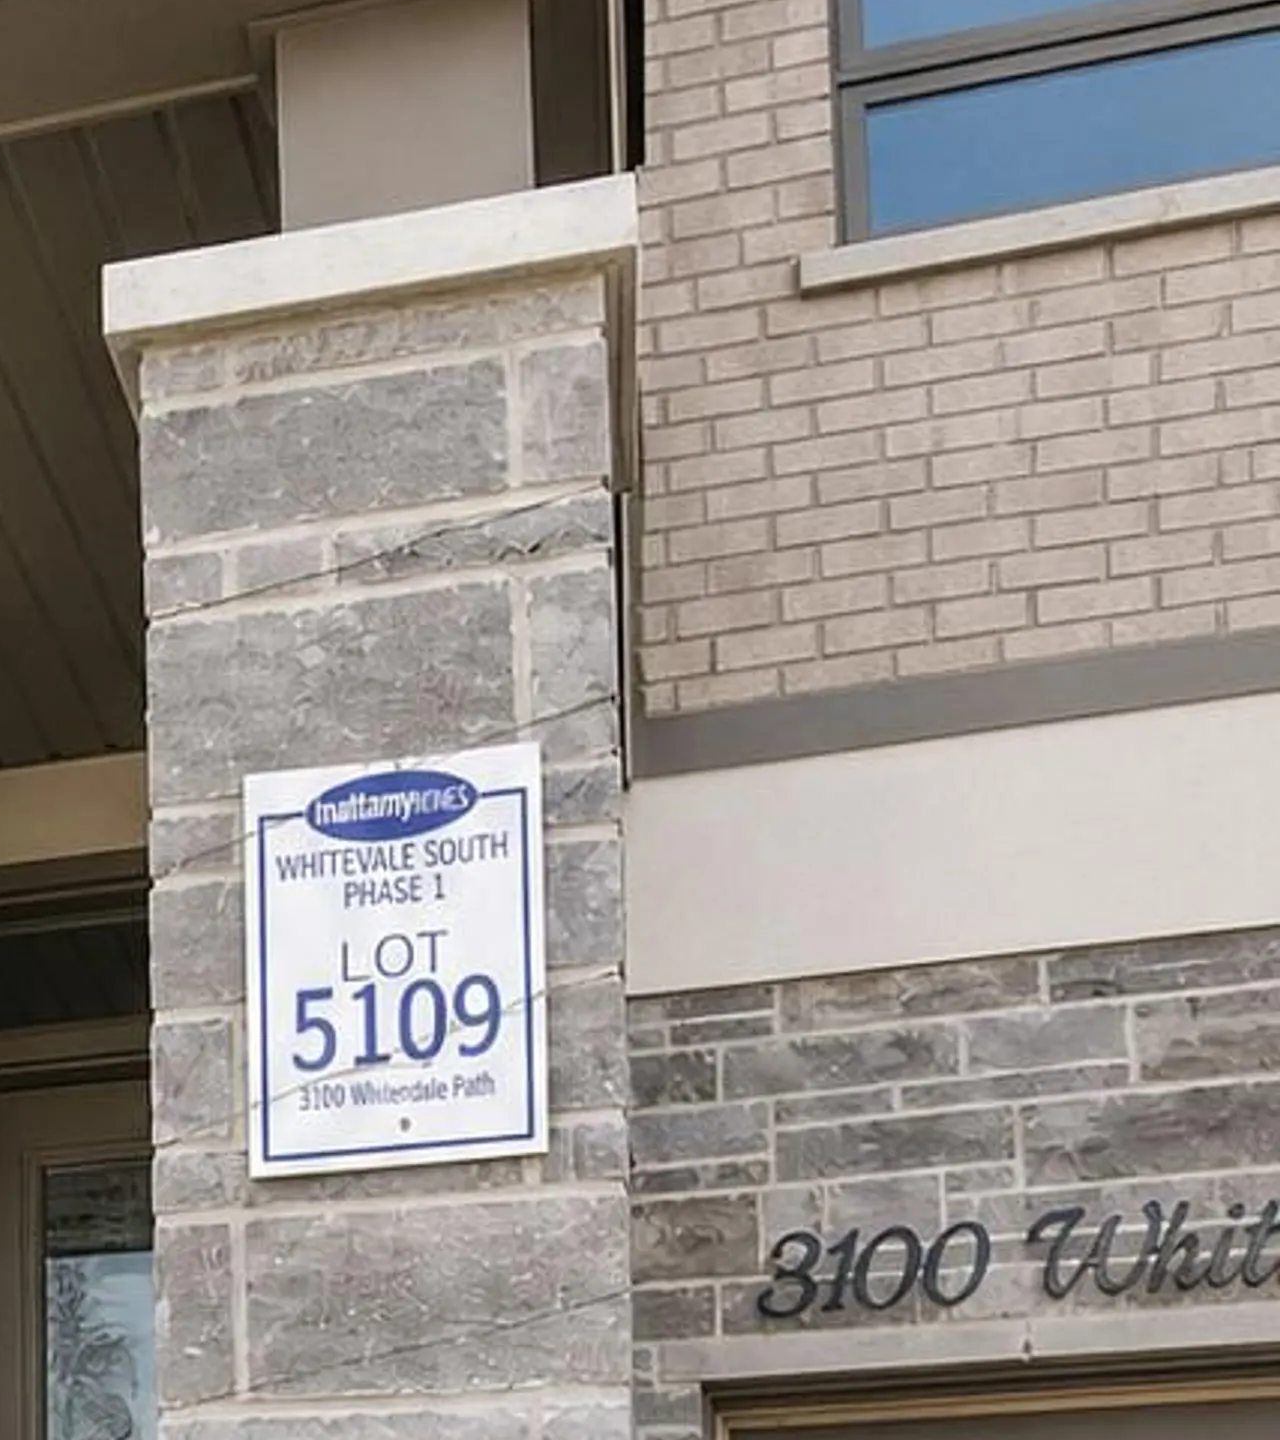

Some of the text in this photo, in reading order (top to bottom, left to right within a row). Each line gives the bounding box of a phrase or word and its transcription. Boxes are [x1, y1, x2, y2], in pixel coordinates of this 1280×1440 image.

[275, 831, 509, 882] WHITEVALE SOUTH
[343, 874, 446, 909] PHASE 1
[341, 930, 449, 983] LOT
[292, 974, 502, 1072] 5109
[299, 1083, 346, 1111] 3100
[452, 1069, 496, 1098] Path
[757, 1220, 992, 1318] 3100
